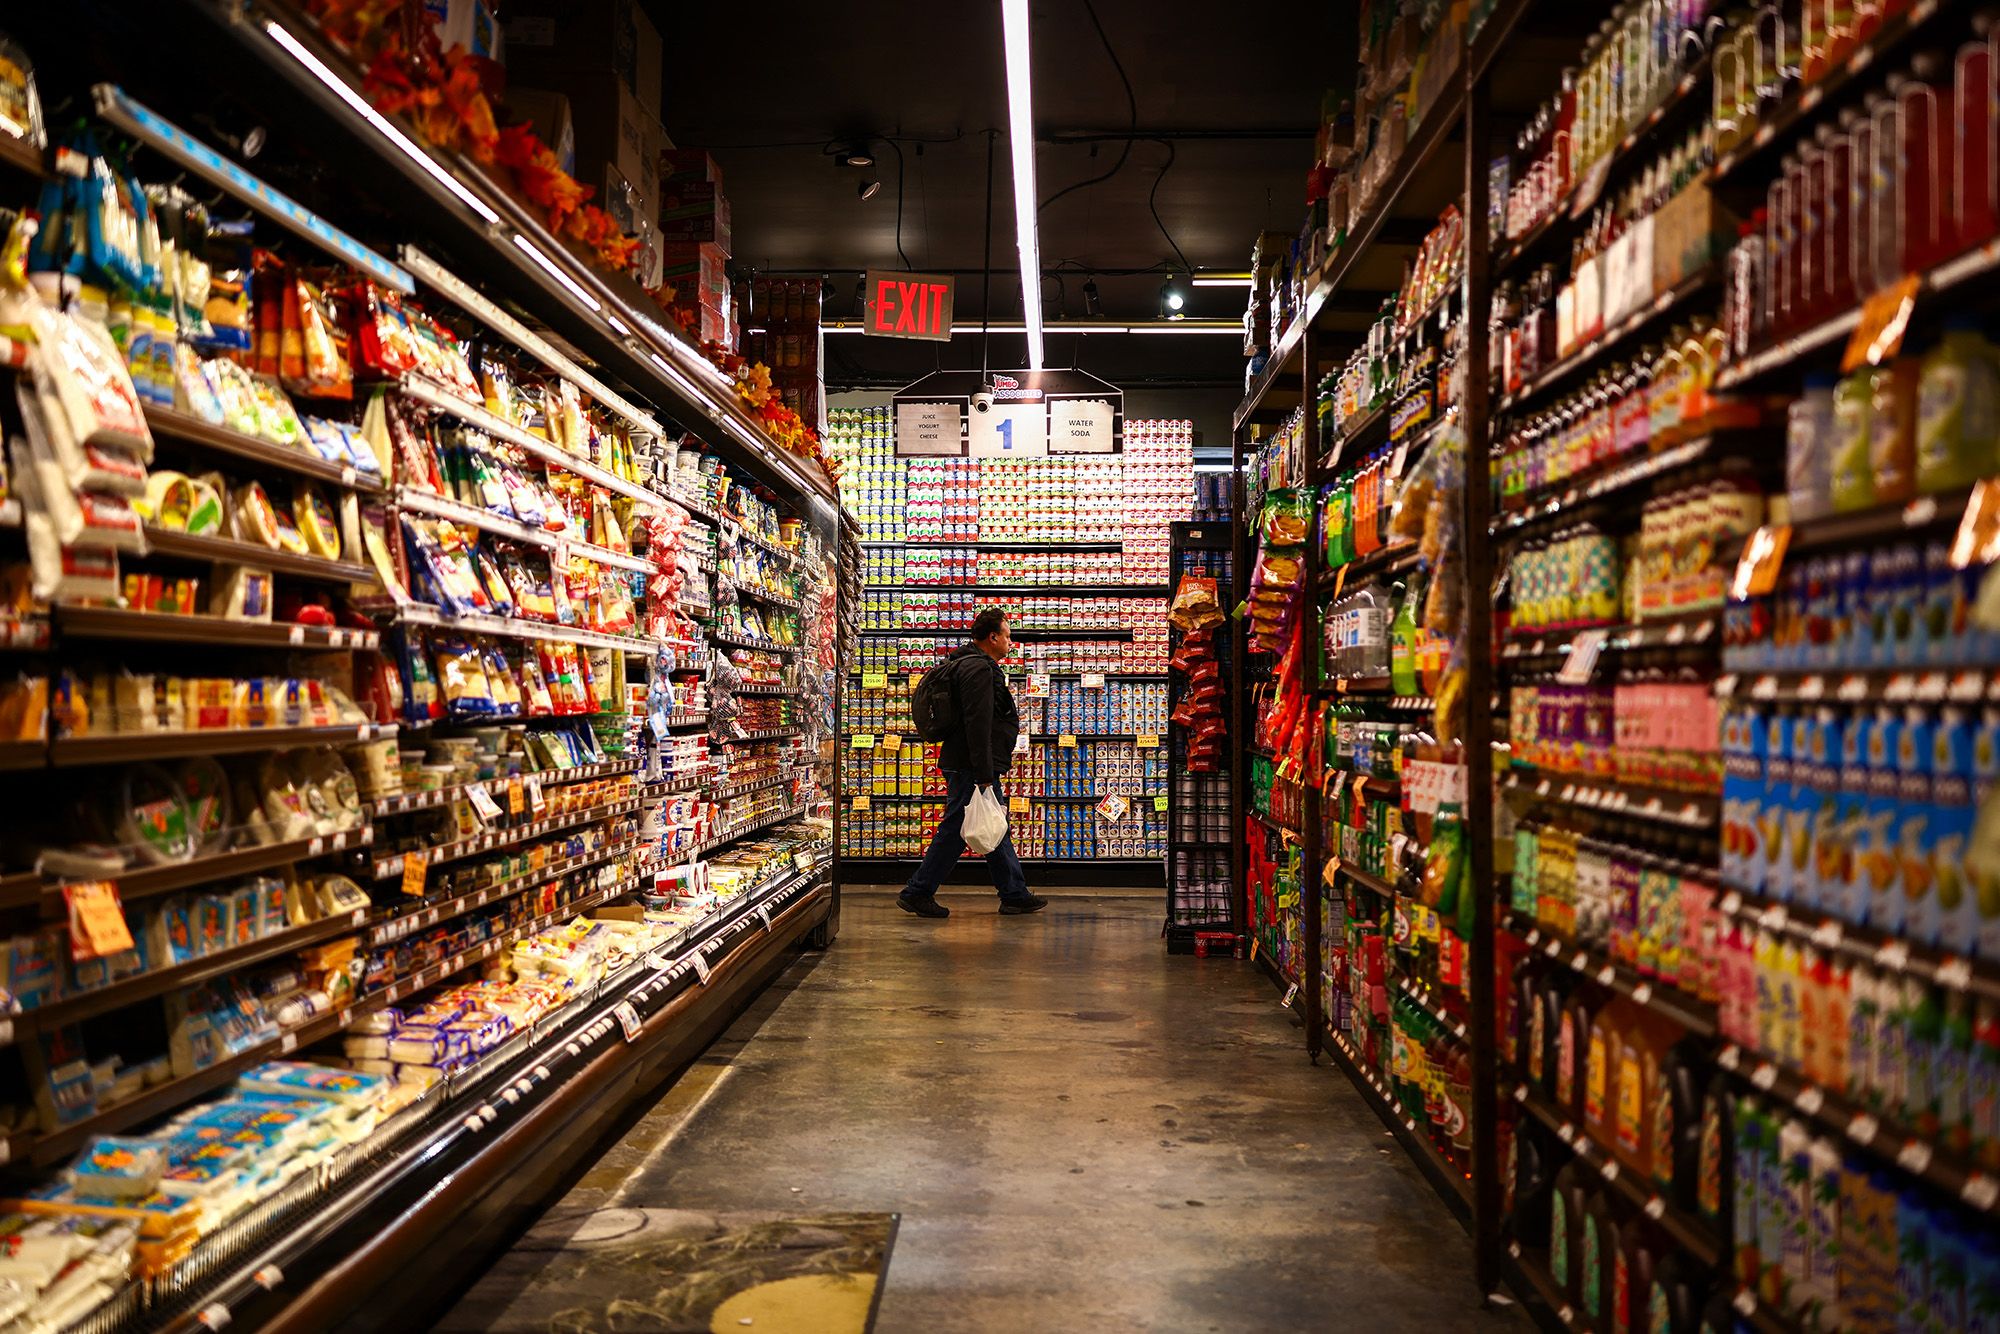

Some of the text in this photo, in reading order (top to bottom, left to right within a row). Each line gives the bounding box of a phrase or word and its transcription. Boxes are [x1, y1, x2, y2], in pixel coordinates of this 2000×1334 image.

[875, 280, 948, 335] EXIT
[995, 380, 1018, 390] JUMBO
[995, 390, 1042, 398] ASSOCIATED
[1068, 419, 1094, 427] WATER
[996, 419, 1012, 450] 1
[1071, 429, 1091, 437] SODA
